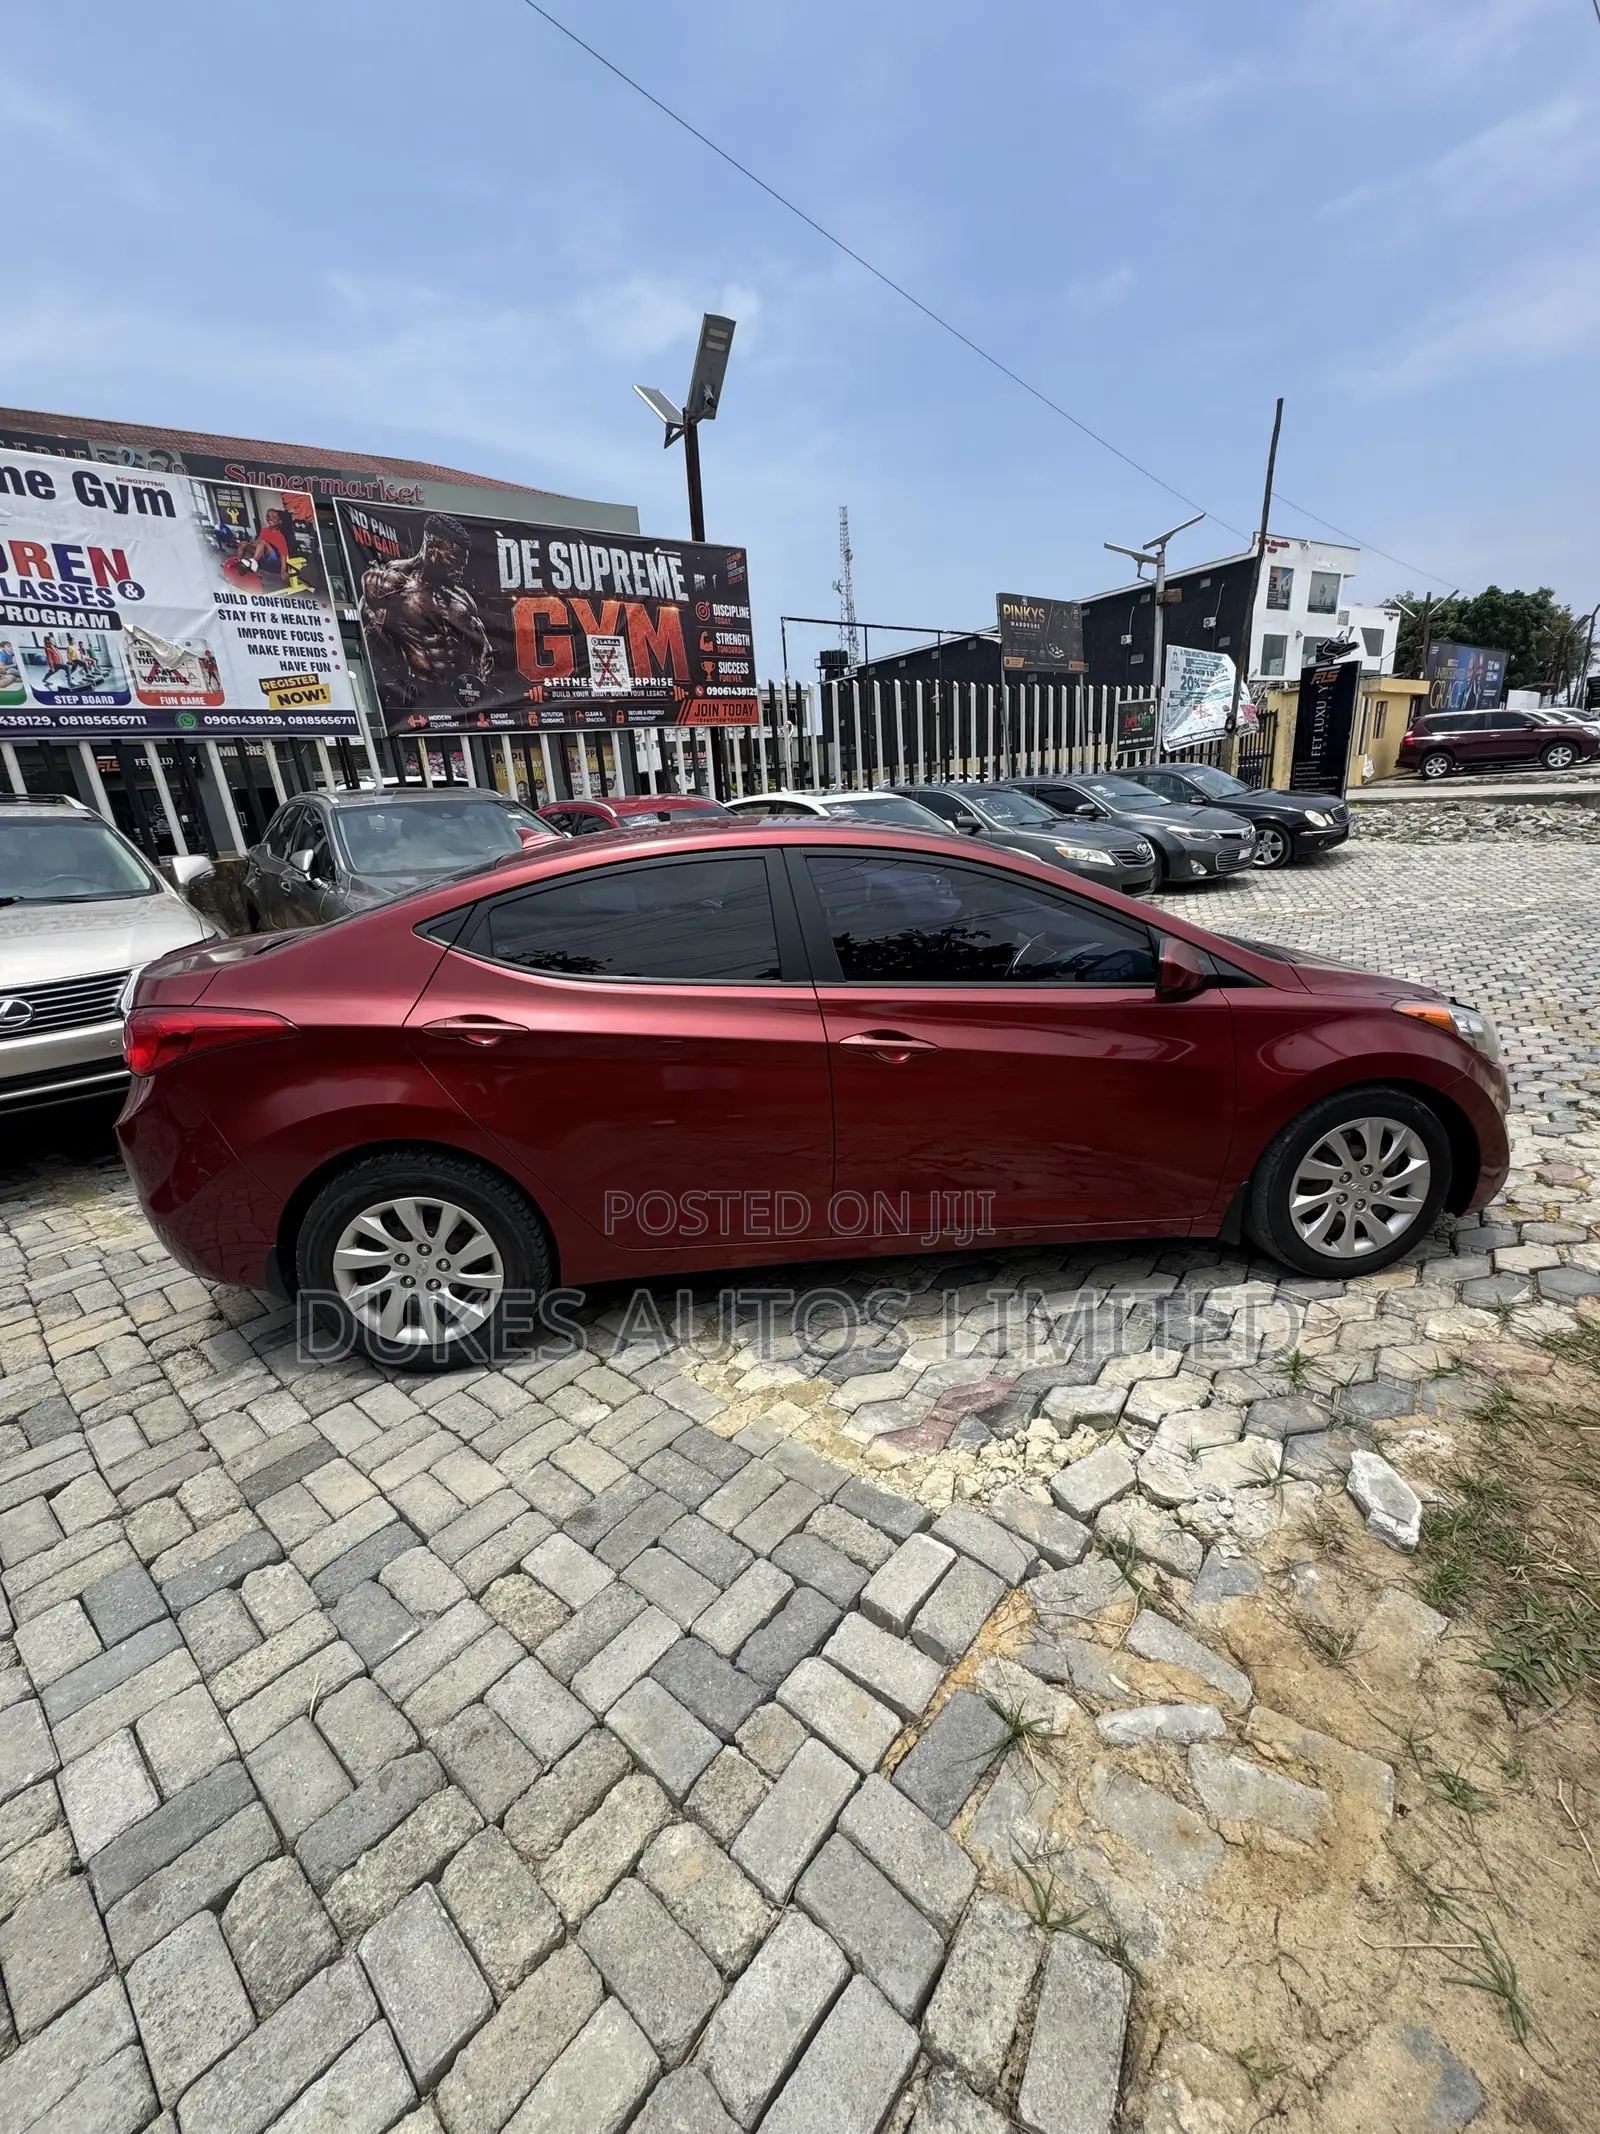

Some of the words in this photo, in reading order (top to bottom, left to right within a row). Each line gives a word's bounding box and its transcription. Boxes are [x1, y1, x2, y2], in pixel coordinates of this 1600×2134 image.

[225, 463, 424, 504] Supermarket
[72, 470, 176, 518] Gym
[349, 508, 368, 530] NO
[370, 516, 398, 543] PAIN
[353, 525, 372, 547] NO
[373, 534, 401, 558] GAIN
[0, 540, 132, 588] REN
[548, 541, 690, 602] SUPREME
[213, 592, 248, 606] BUILD
[250, 595, 319, 611] CONFIDENCE
[218, 609, 246, 622] STAY
[250, 612, 267, 624] FIT
[270, 613, 279, 624] &
[281, 614, 322, 627] HEALTH
[712, 604, 750, 619] DISCIPLINE
[1003, 603, 1046, 623] PINKYS
[237, 627, 288, 641] IMPROVE
[290, 631, 325, 643] FOCUS
[512, 596, 692, 684] GYM
[716, 632, 750, 647] STRENGTH
[247, 644, 280, 656] MAKE
[283, 646, 328, 658] FRIENDS
[279, 661, 308, 672] HAVE
[310, 662, 332, 673] FUN
[718, 661, 749, 675] SUCCESS
[261, 676, 318, 690] REGISTER
[277, 688, 328, 706] NOW!
[706, 687, 757, 696] 09061438129
[54, 695, 79, 704] STEP
[82, 695, 115, 705] BOARD
[160, 697, 178, 705] FUN
[180, 697, 206, 705] GAME
[694, 704, 719, 717] JOIN
[722, 704, 754, 717] TODAY
[59, 716, 147, 725] 08185656711
[204, 716, 286, 726] 09061438129,
[288, 717, 356, 725] 08185656711
[1310, 736, 1323, 757] FET
